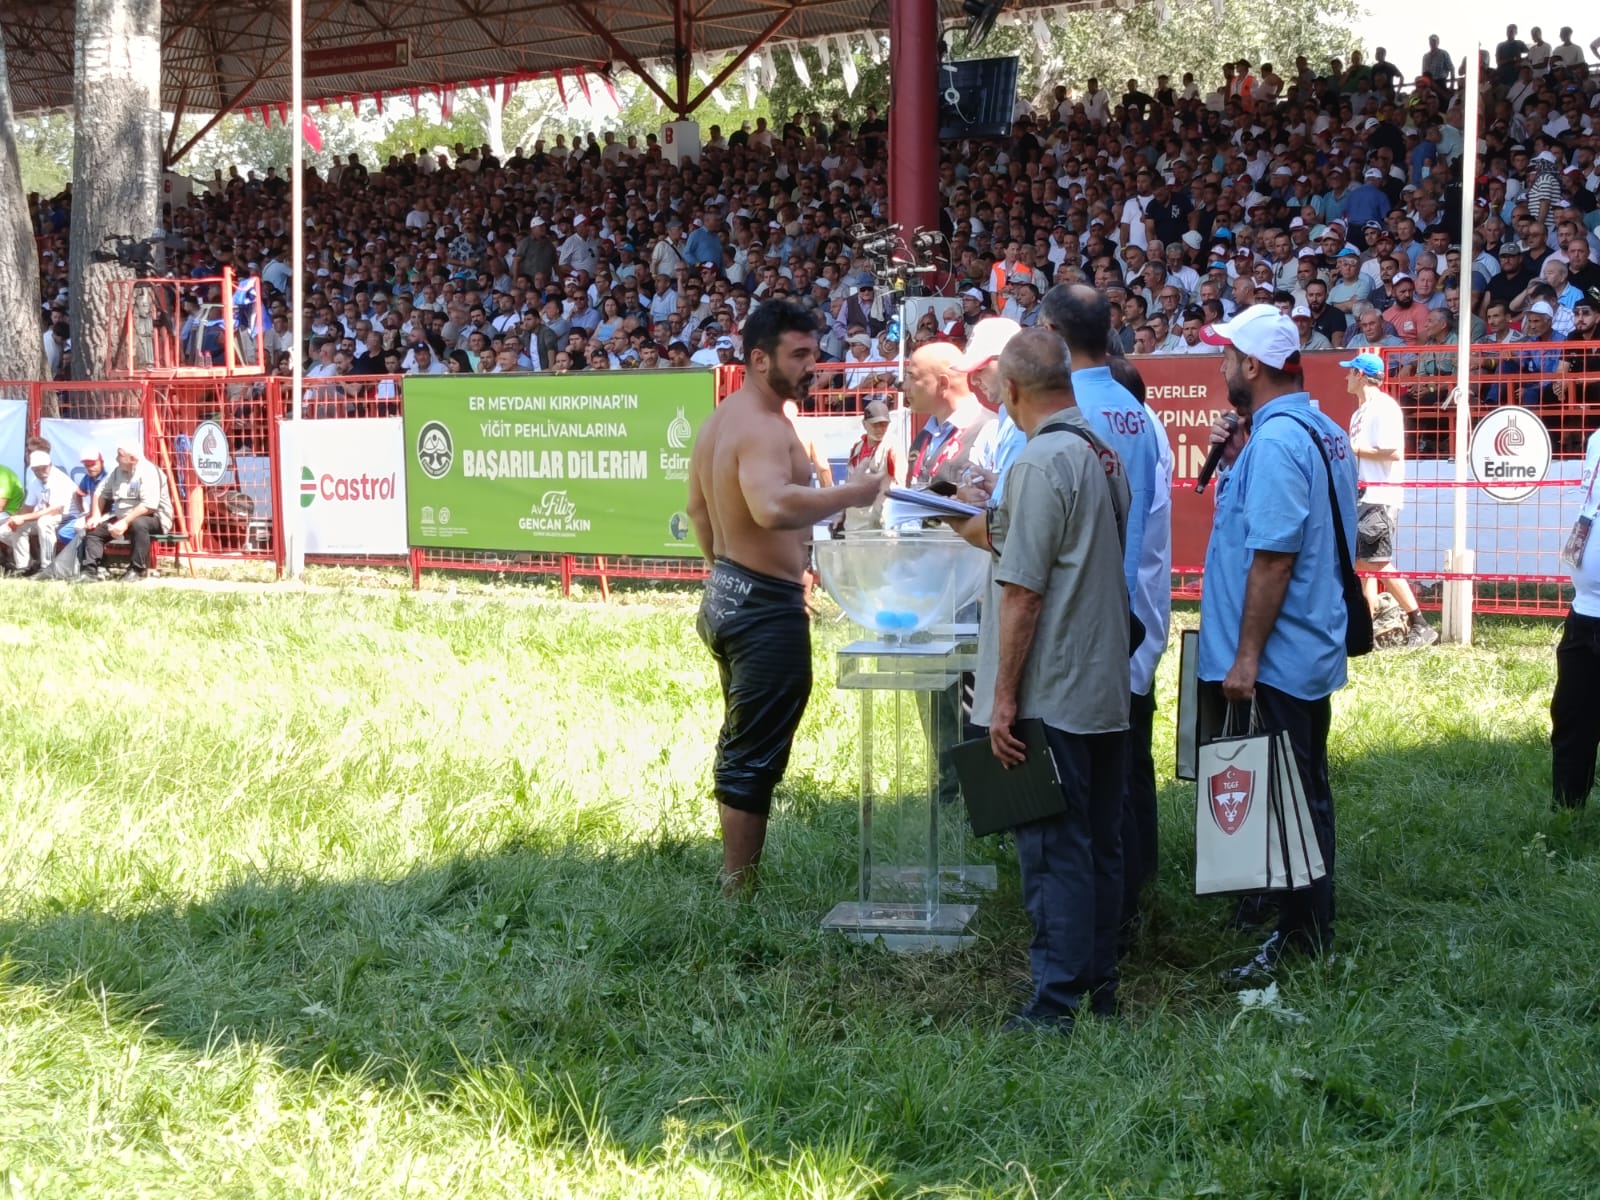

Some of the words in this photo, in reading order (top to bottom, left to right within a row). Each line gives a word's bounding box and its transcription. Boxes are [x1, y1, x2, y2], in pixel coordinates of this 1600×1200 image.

[1146, 386, 1207, 399] EVERLER
[469, 397, 485, 411] ER
[488, 396, 546, 411] MEYDANI
[550, 394, 638, 410] KIRKPINAR'IN
[480, 420, 511, 438] YİĞİT
[515, 419, 627, 438] PEHLİVANLARINA
[463, 449, 565, 480] BAŞARILAR
[567, 450, 648, 479] DİLERİM
[660, 452, 691, 469] Edir
[1170, 433, 1217, 478] İN
[1484, 461, 1537, 478] Edirne
[320, 472, 396, 501] Castrol
[541, 490, 577, 522] Filiz
[518, 518, 562, 531] GENCAN
[565, 519, 591, 531] AKIN
